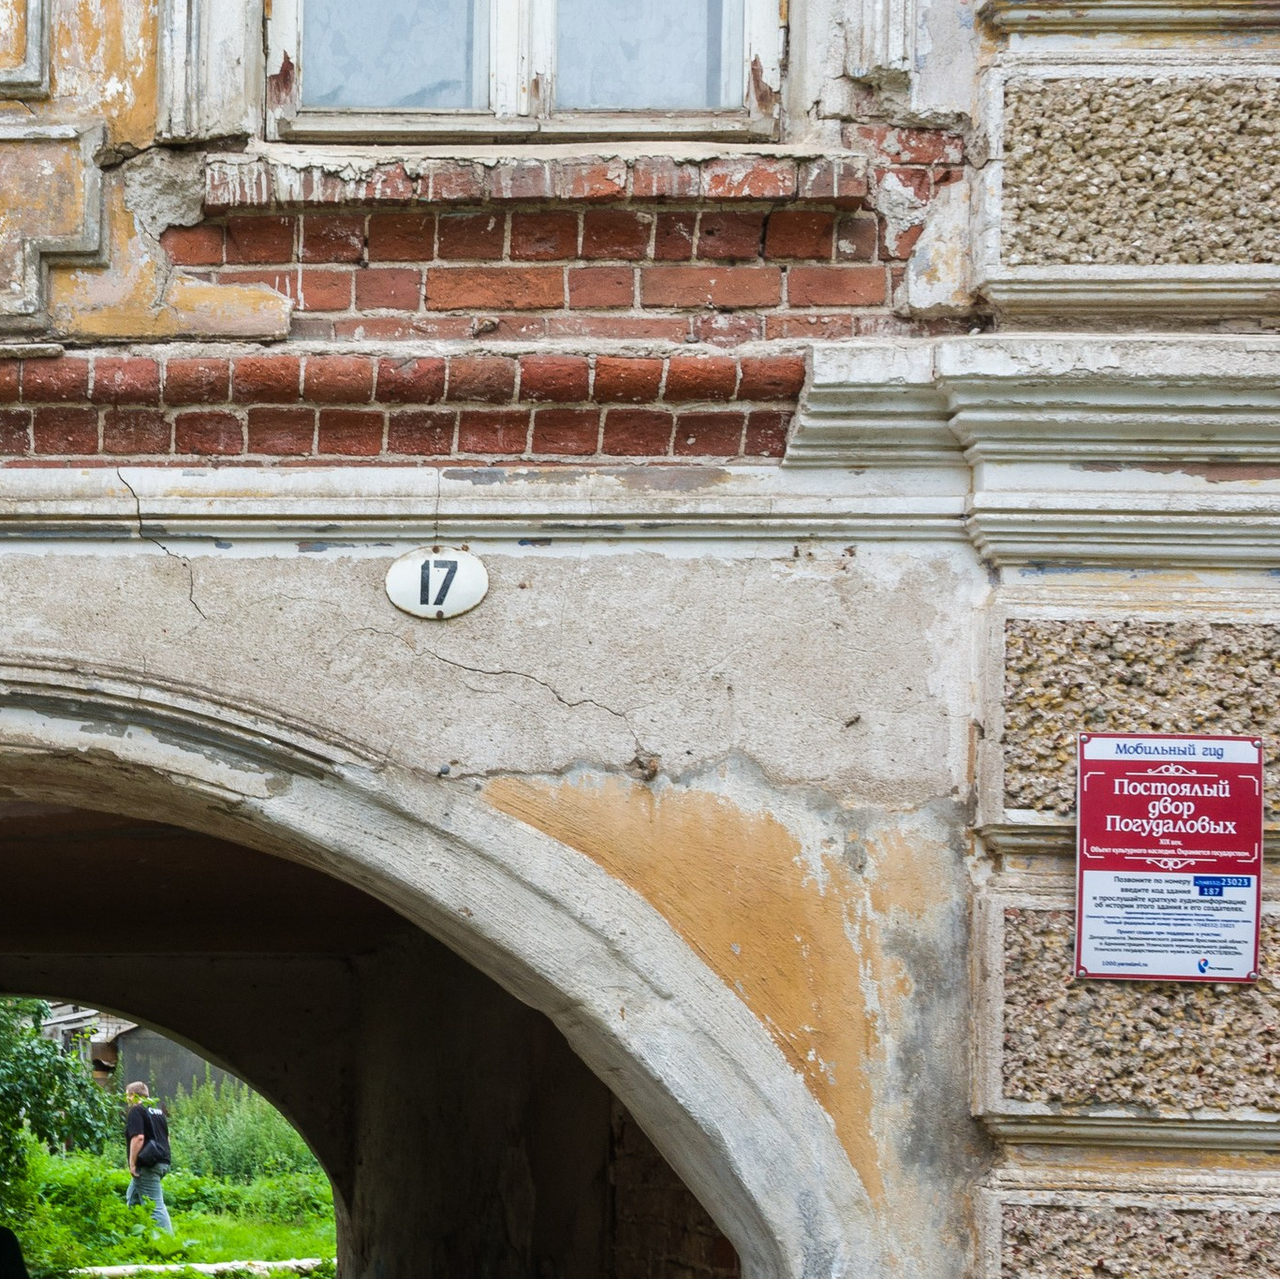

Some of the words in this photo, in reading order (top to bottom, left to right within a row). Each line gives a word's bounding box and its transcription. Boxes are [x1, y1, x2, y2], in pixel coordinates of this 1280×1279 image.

[420, 560, 458, 606] 17
[1115, 743, 1196, 756] Мобильный
[1202, 747, 1224, 759] гид
[1113, 778, 1230, 797] Постоялый
[1148, 797, 1195, 818] двор
[1106, 815, 1237, 837] Погудаловых
[1114, 875, 1152, 883] Позвоните
[1221, 878, 1248, 886] 23023
[1099, 895, 1146, 903] прослушайте
